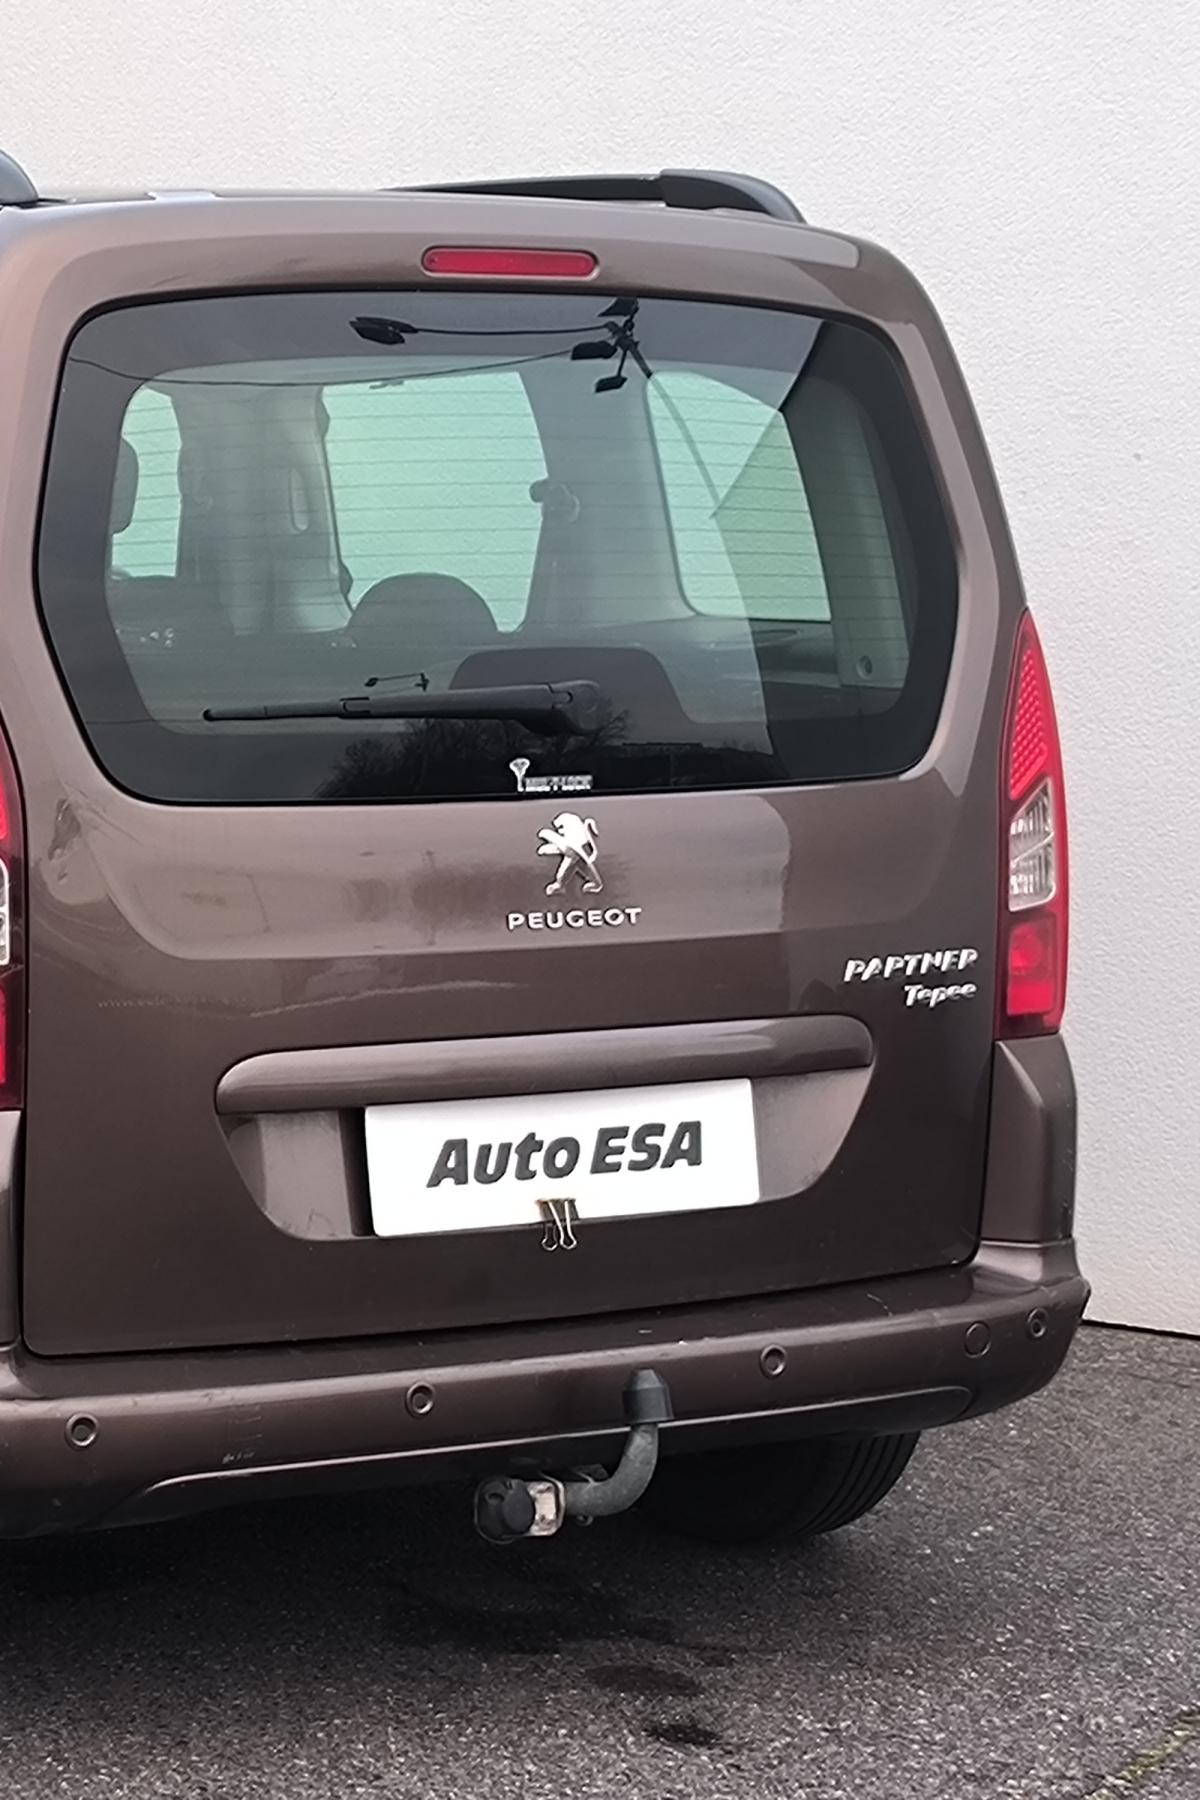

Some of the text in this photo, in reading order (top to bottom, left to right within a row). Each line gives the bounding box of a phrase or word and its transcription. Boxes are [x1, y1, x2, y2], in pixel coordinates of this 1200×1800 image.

[507, 908, 642, 931] PEUGEOT
[843, 949, 978, 982] PARTNER
[904, 983, 977, 1007] Tepee
[426, 1121, 702, 1188] Auto ESA
